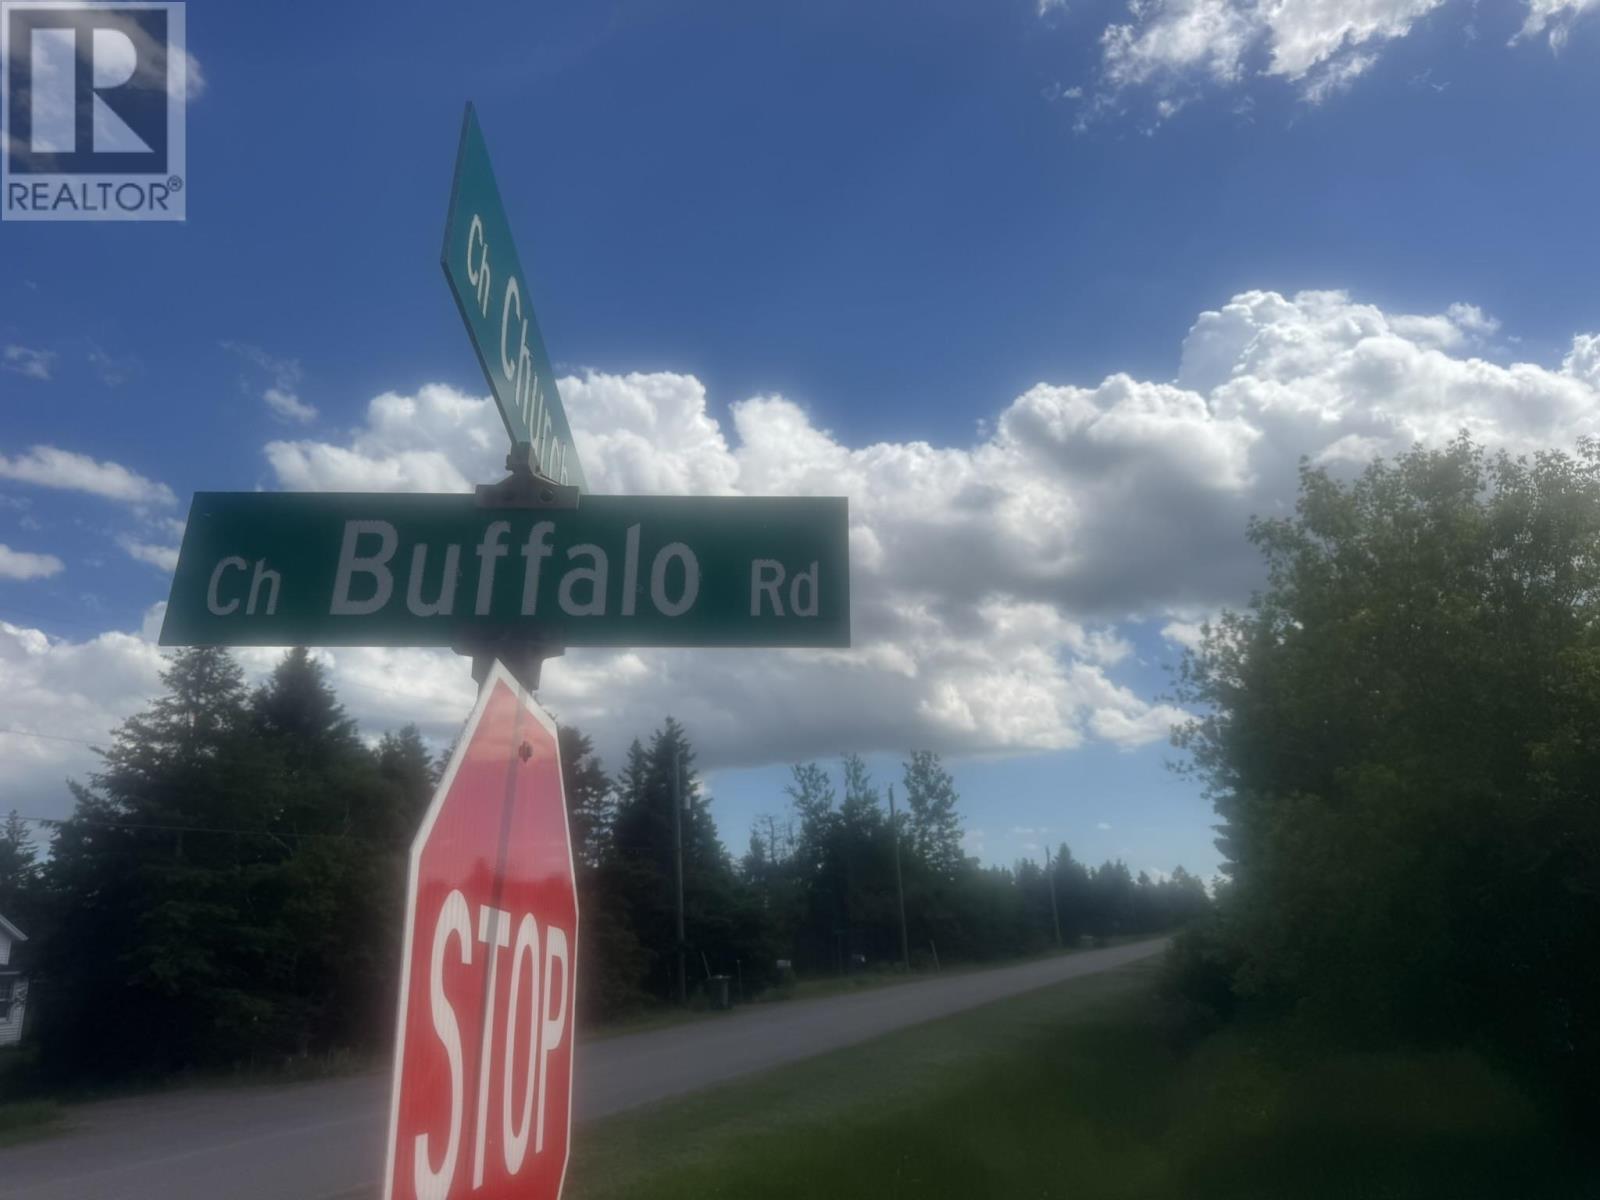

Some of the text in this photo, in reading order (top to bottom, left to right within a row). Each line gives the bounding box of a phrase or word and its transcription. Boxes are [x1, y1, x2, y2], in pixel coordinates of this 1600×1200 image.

[467, 214, 569, 487] Ch Church
[206, 519, 819, 616] Ch Buffalo Rd
[414, 888, 568, 1200] STOP
